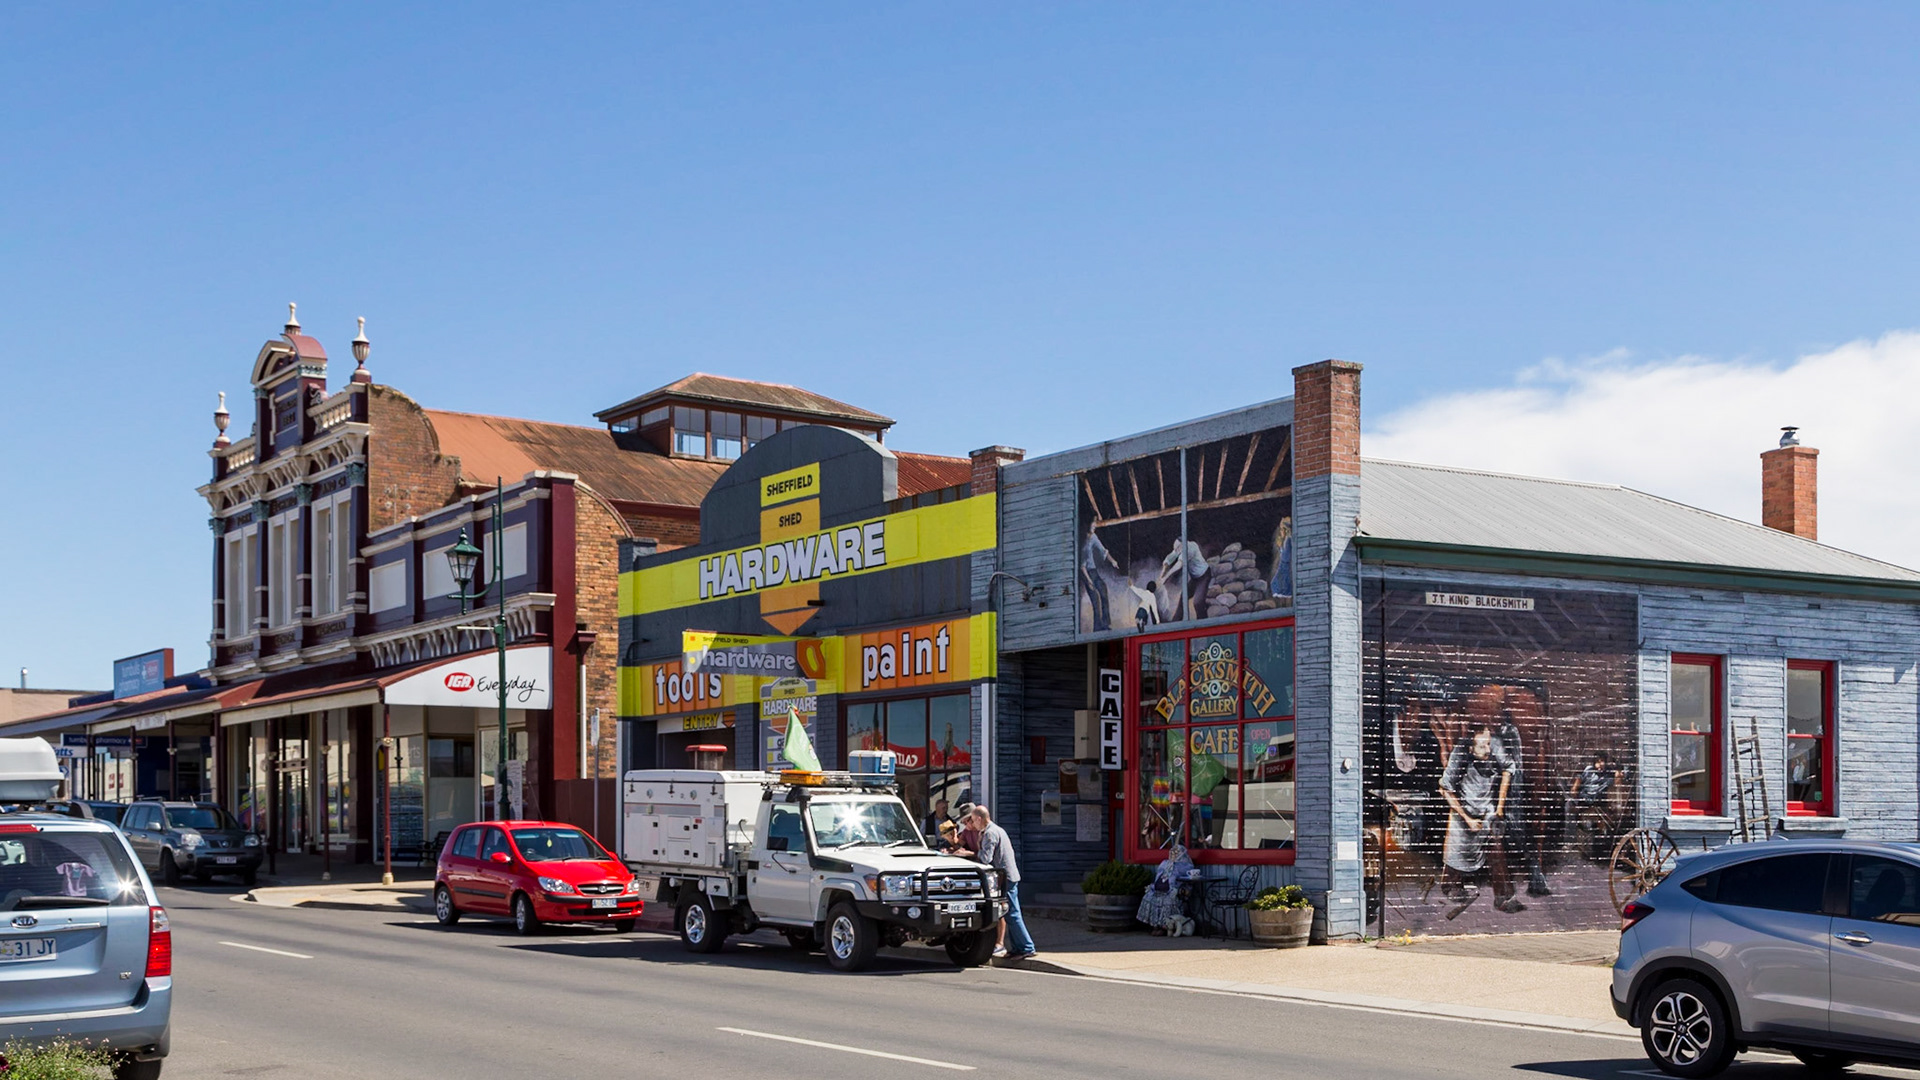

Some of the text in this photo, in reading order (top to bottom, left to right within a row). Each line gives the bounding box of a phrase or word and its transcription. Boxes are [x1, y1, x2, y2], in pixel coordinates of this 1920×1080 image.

[766, 474, 813, 497] SHEFFIELD
[778, 512, 803, 527] SHED
[699, 519, 887, 600] HARDWARE
[1449, 595, 1469, 606] KING
[1475, 596, 1528, 609] BLACKSMITH
[702, 644, 796, 671] hardware
[863, 624, 950, 688] paint
[447, 675, 545, 702] IGA Eveyday
[655, 667, 722, 706] tools
[1154, 660, 1277, 723] BLACKSMITH
[1190, 696, 1240, 717] GALLERY
[683, 714, 719, 730] ENTRY
[1101, 673, 1120, 765] CAFE
[1190, 728, 1240, 755] CAFE
[1250, 728, 1271, 740] OPEN
[53, 746, 74, 757] atts
[16, 917, 34, 926] KIA
[15, 940, 54, 957] 31 JY
